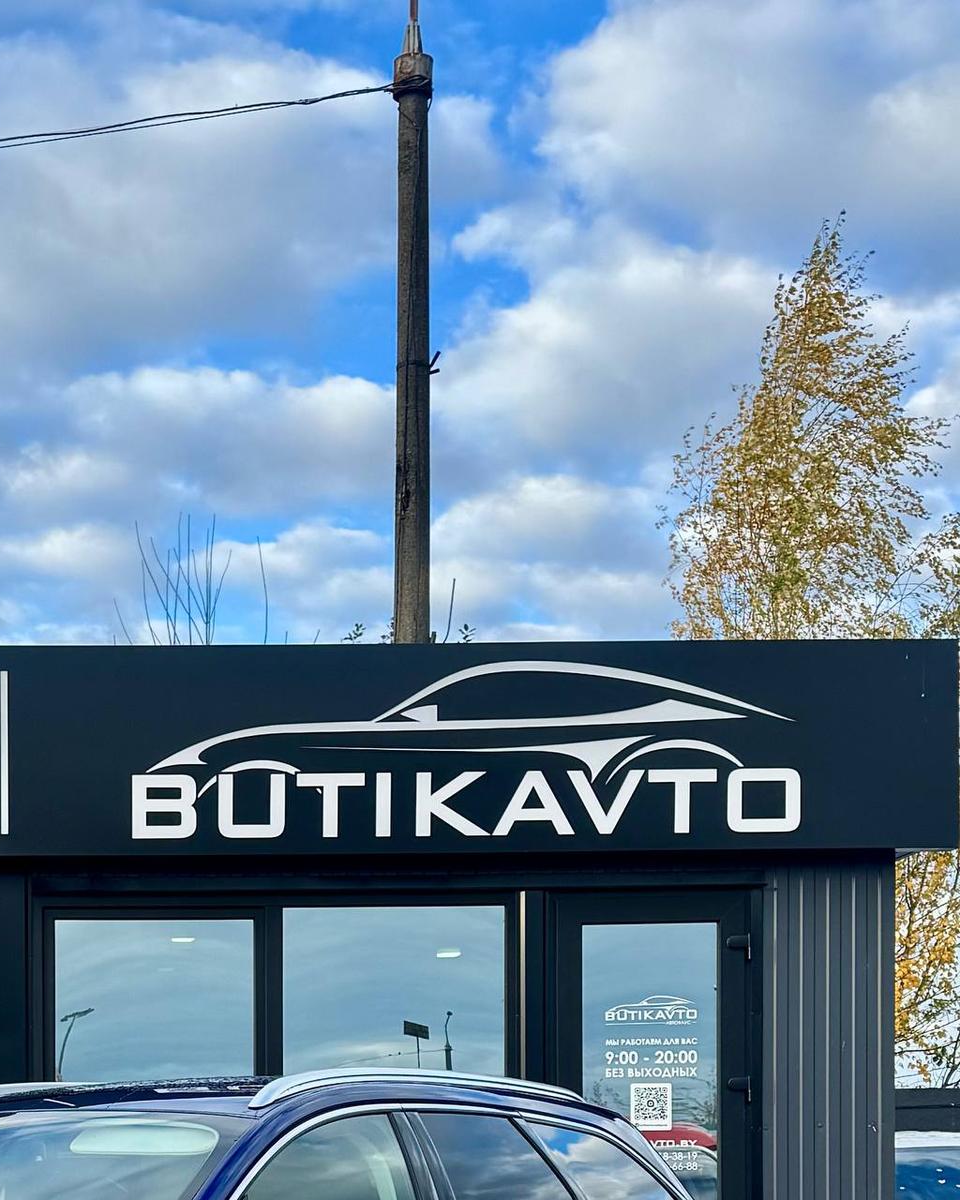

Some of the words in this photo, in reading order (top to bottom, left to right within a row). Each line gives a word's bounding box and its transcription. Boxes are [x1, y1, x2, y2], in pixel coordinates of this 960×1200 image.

[131, 767, 802, 840] BUTIKAVTO
[605, 1008, 698, 1022] BUTIKAVTO
[605, 1038, 620, 1046] МЫ
[621, 1038, 662, 1046] РАБОТАЕМ
[663, 1038, 680, 1046] ДЛЯ
[681, 1037, 698, 1045] ВАС
[605, 1050, 639, 1065] 9:00
[654, 1050, 698, 1064] 20:00
[605, 1067, 624, 1078] БЕЗ
[627, 1067, 698, 1079] ВЫХОДНЫХ
[650, 1139, 698, 1148] VTO.BY
[657, 1152, 698, 1161] 8-38-19
